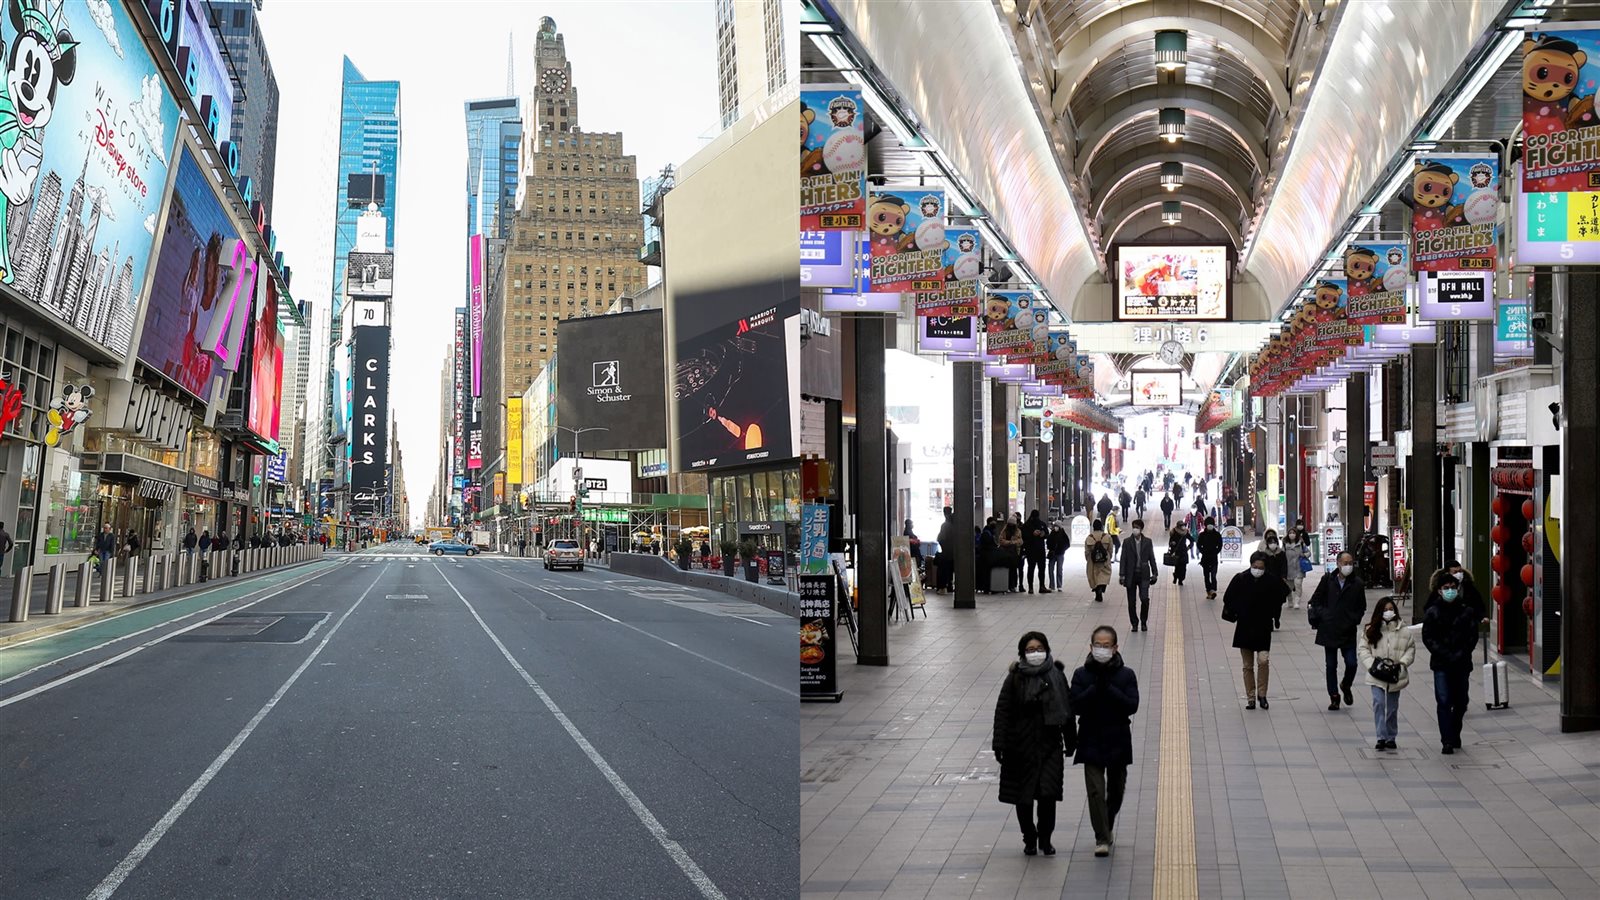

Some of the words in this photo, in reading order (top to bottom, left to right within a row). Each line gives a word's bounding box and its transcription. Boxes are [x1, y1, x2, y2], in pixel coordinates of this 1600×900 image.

[94, 80, 151, 171] WELCOME
[1527, 135, 1548, 148] GO
[1551, 130, 1578, 144] FOR
[95, 108, 128, 177] Disney
[125, 166, 147, 198] store
[78, 130, 89, 145] AT
[93, 145, 115, 179] TIMES
[119, 178, 146, 215] SQUARE
[811, 175, 832, 186] THE
[834, 171, 860, 184] WIN!
[822, 216, 860, 226] 狸小路
[1416, 230, 1431, 239] GO
[1433, 228, 1452, 237] FOR
[1454, 226, 1470, 234] THE
[1471, 222, 1494, 232] WIN!
[1416, 232, 1493, 255] FIGHTERS
[1560, 243, 1574, 259] 5
[872, 256, 885, 264] GO
[888, 254, 904, 262] FOR
[906, 251, 921, 260] THE
[922, 248, 942, 258] WIN!
[1461, 258, 1491, 267] 狸小路
[800, 267, 812, 282] 5
[872, 257, 942, 278] FIGHTERS
[1441, 282, 1456, 291] BFH
[1461, 282, 1481, 291] HALL
[857, 296, 867, 307] 5
[917, 287, 977, 304] FIGHTERS
[1361, 294, 1374, 302] FOR
[364, 305, 374, 320] 70
[1349, 297, 1405, 313] FIGHTERS
[1451, 304, 1461, 316] 5
[750, 307, 777, 321] MARRIOTT
[750, 315, 774, 329] MARQUIS
[1134, 326, 1192, 345] 狸小路
[1197, 326, 1208, 344] 6
[1317, 325, 1362, 336] FIGHTERS
[1401, 331, 1410, 340] 5
[944, 338, 953, 348] 5
[988, 334, 1031, 346] FIGHTERS
[587, 387, 613, 395] Simon
[614, 385, 622, 393] &
[597, 394, 632, 403] Schuster
[121, 376, 193, 452] FOREVER
[363, 359, 378, 465] CLARKS
[586, 480, 606, 488] BT21
[813, 509, 827, 537] 生乳
[803, 517, 812, 574] ソフトクリーム
[1328, 542, 1342, 556] 薬
